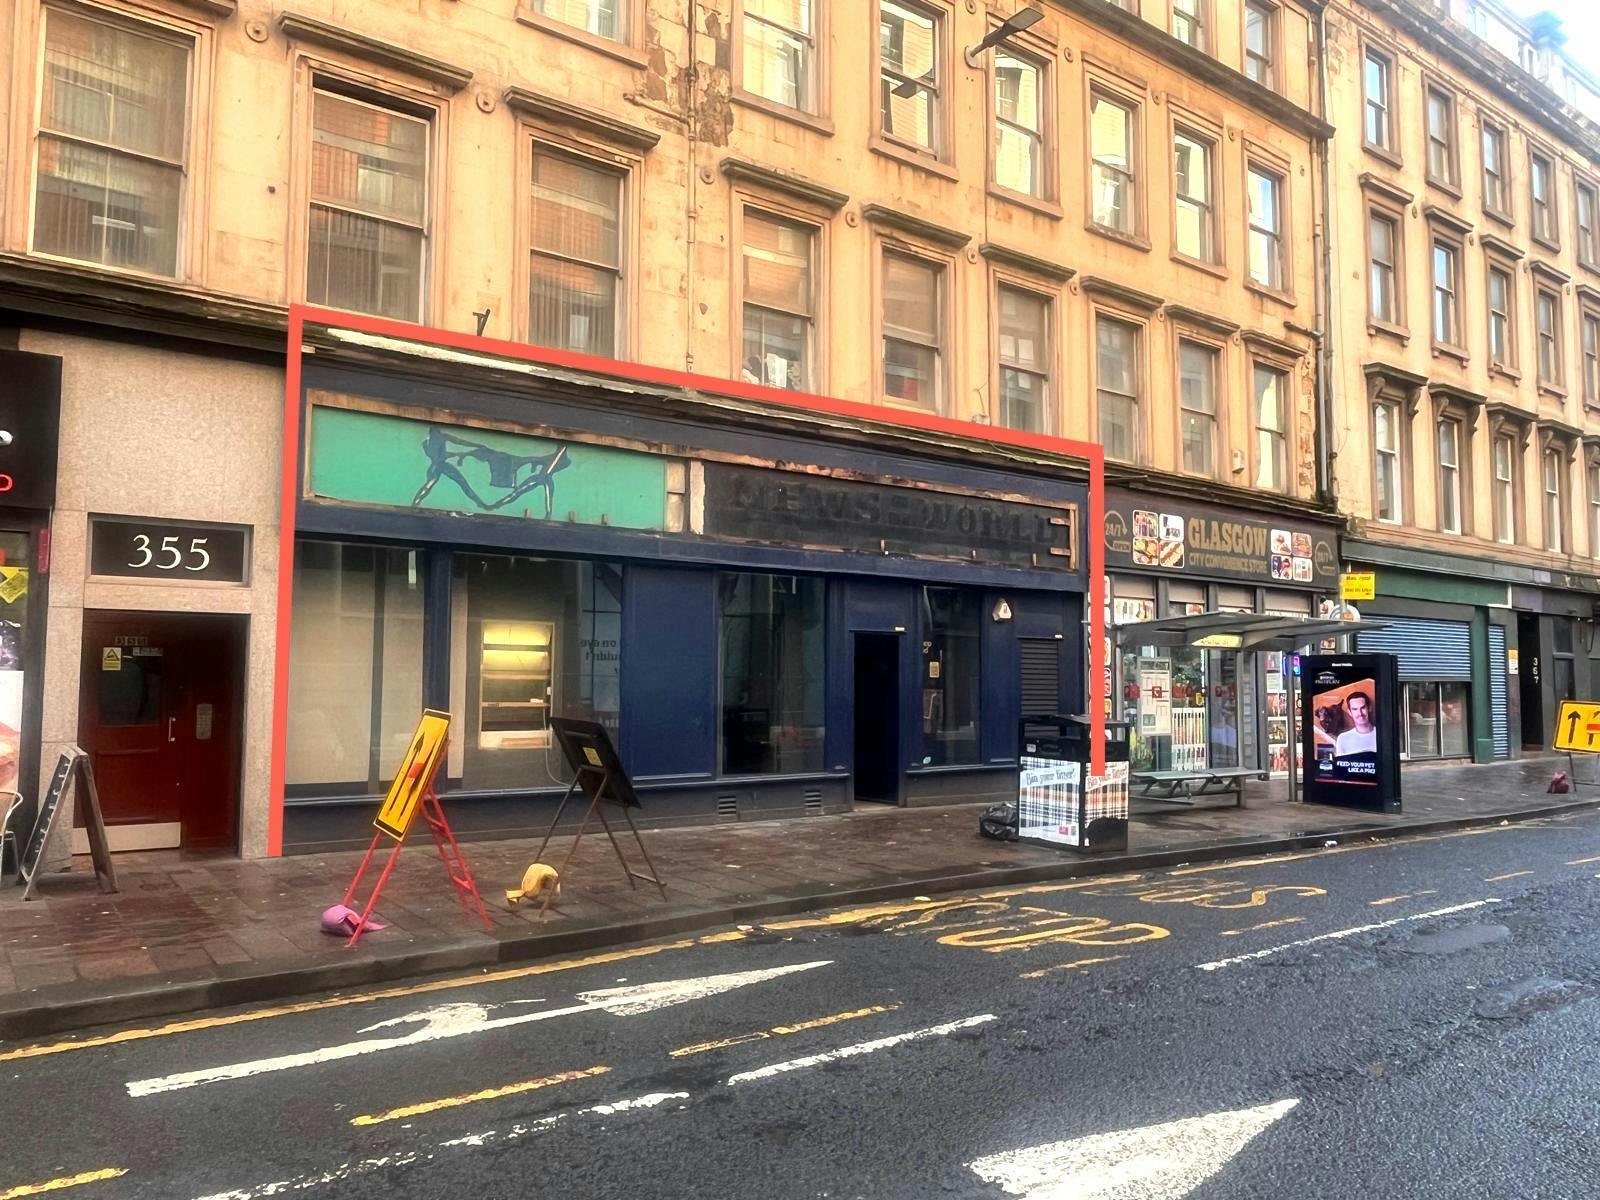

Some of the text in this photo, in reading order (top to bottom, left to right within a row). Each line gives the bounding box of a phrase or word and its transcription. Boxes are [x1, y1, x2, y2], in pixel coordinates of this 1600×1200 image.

[127, 534, 210, 571] 355
[1187, 517, 1268, 557] GLASGOW
[1189, 552, 1204, 567] CITY
[1249, 558, 1267, 574] STORE
[1532, 657, 1540, 684] 367
